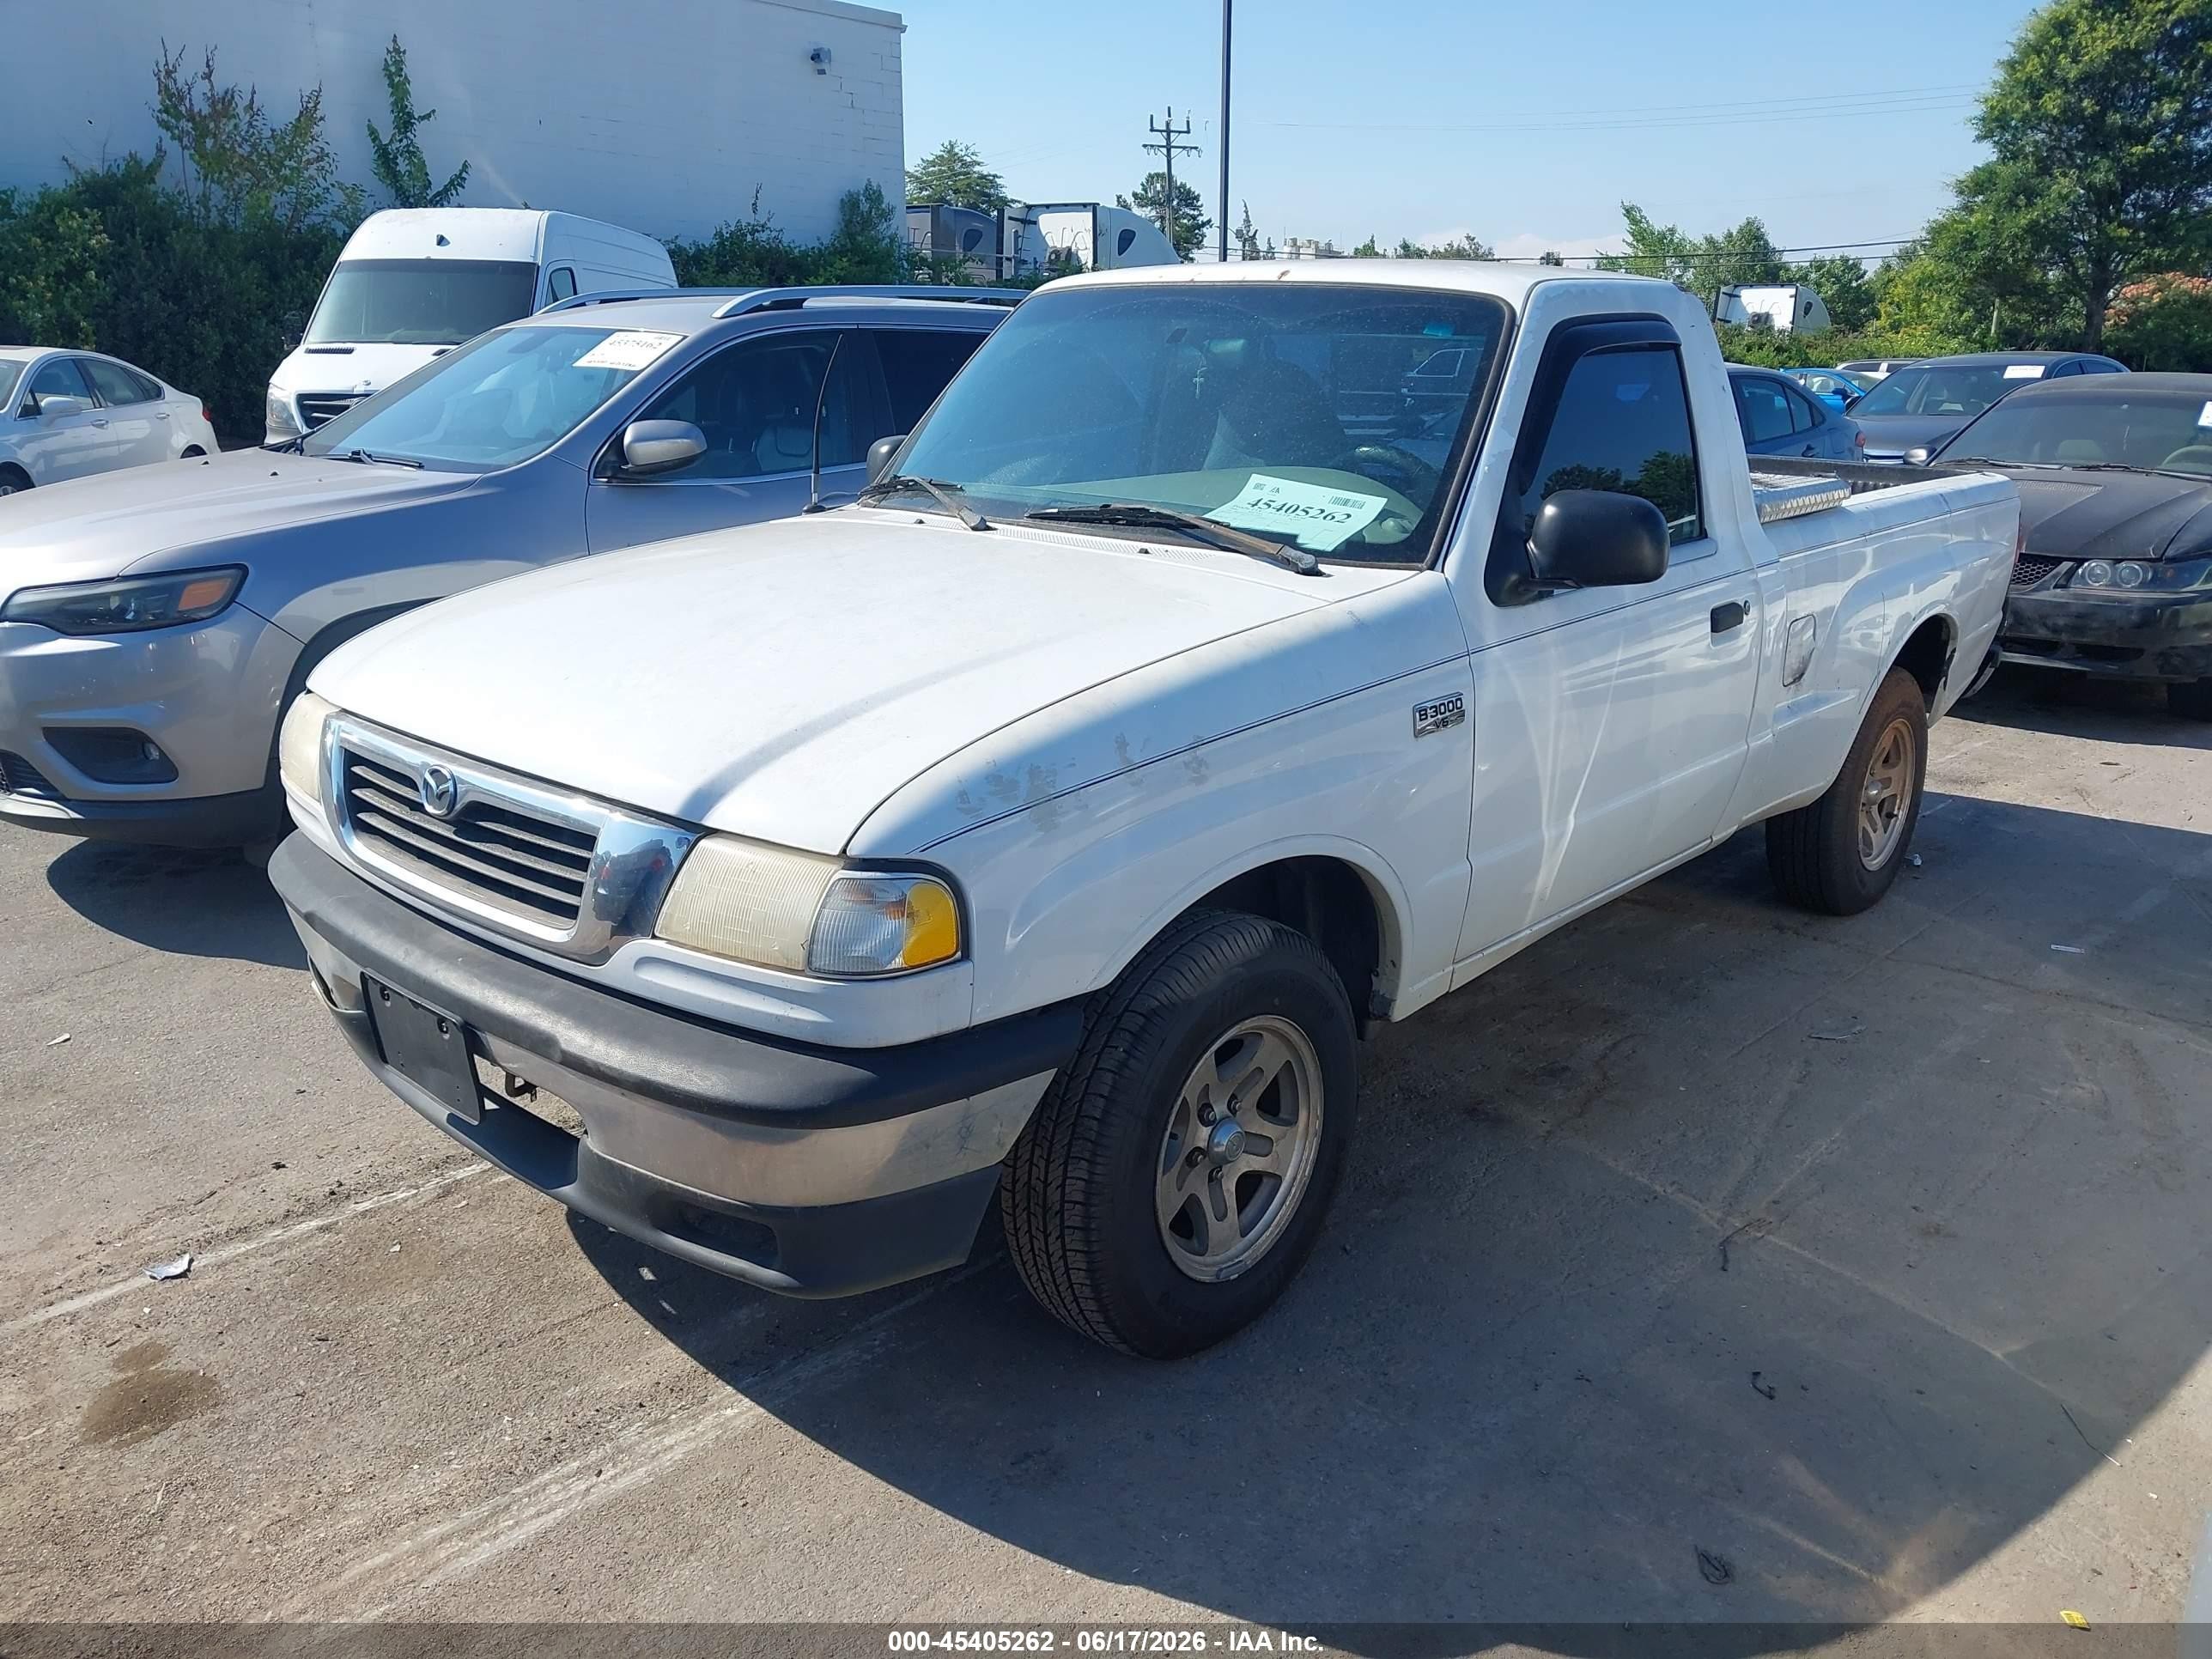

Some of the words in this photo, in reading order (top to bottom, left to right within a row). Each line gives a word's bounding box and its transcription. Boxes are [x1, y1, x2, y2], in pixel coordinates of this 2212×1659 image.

[1247, 497, 1352, 524] 45405262
[1419, 697, 1463, 722] B3000
[1435, 717, 1449, 729] V6
